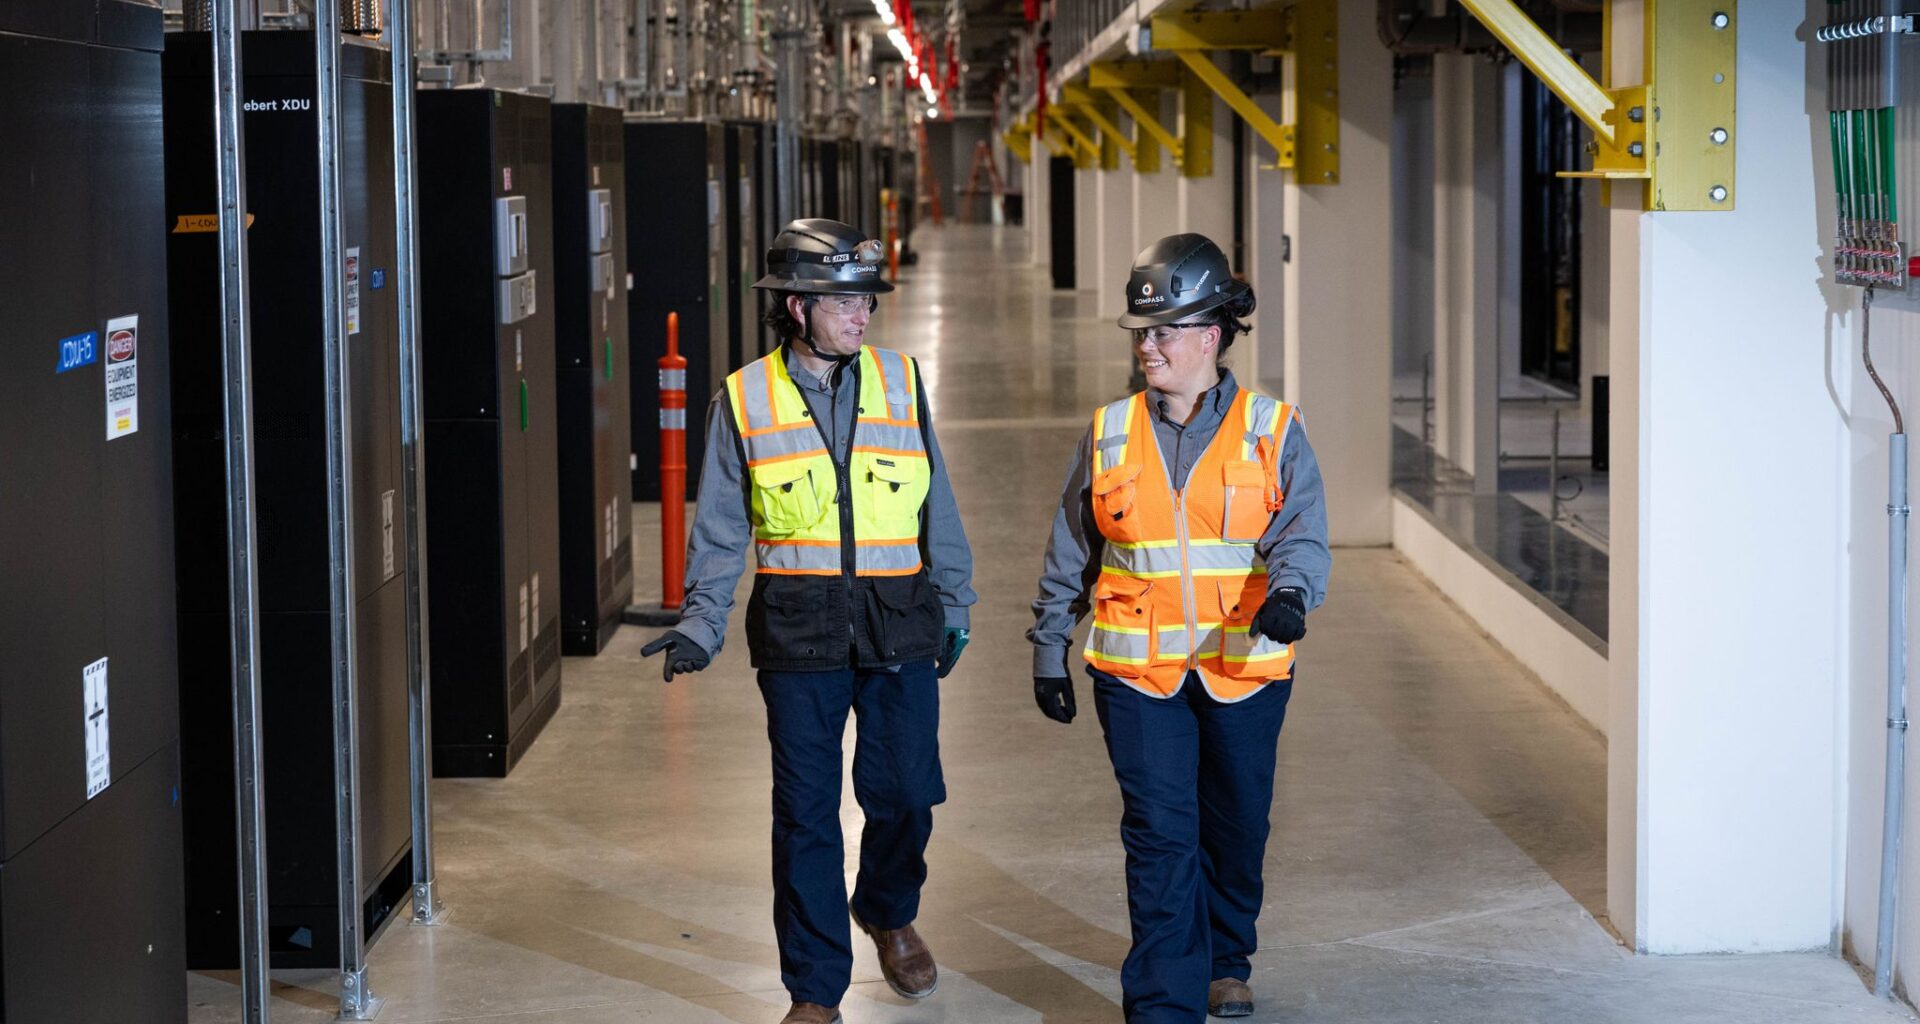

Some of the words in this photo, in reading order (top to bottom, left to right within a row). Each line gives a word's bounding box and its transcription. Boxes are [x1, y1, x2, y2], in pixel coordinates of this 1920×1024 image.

[243, 99, 277, 111] ebert
[282, 99, 311, 110] XDU
[851, 265, 877, 273] COMPASS
[1135, 295, 1164, 305] COMPASS
[109, 336, 135, 355] DANGER
